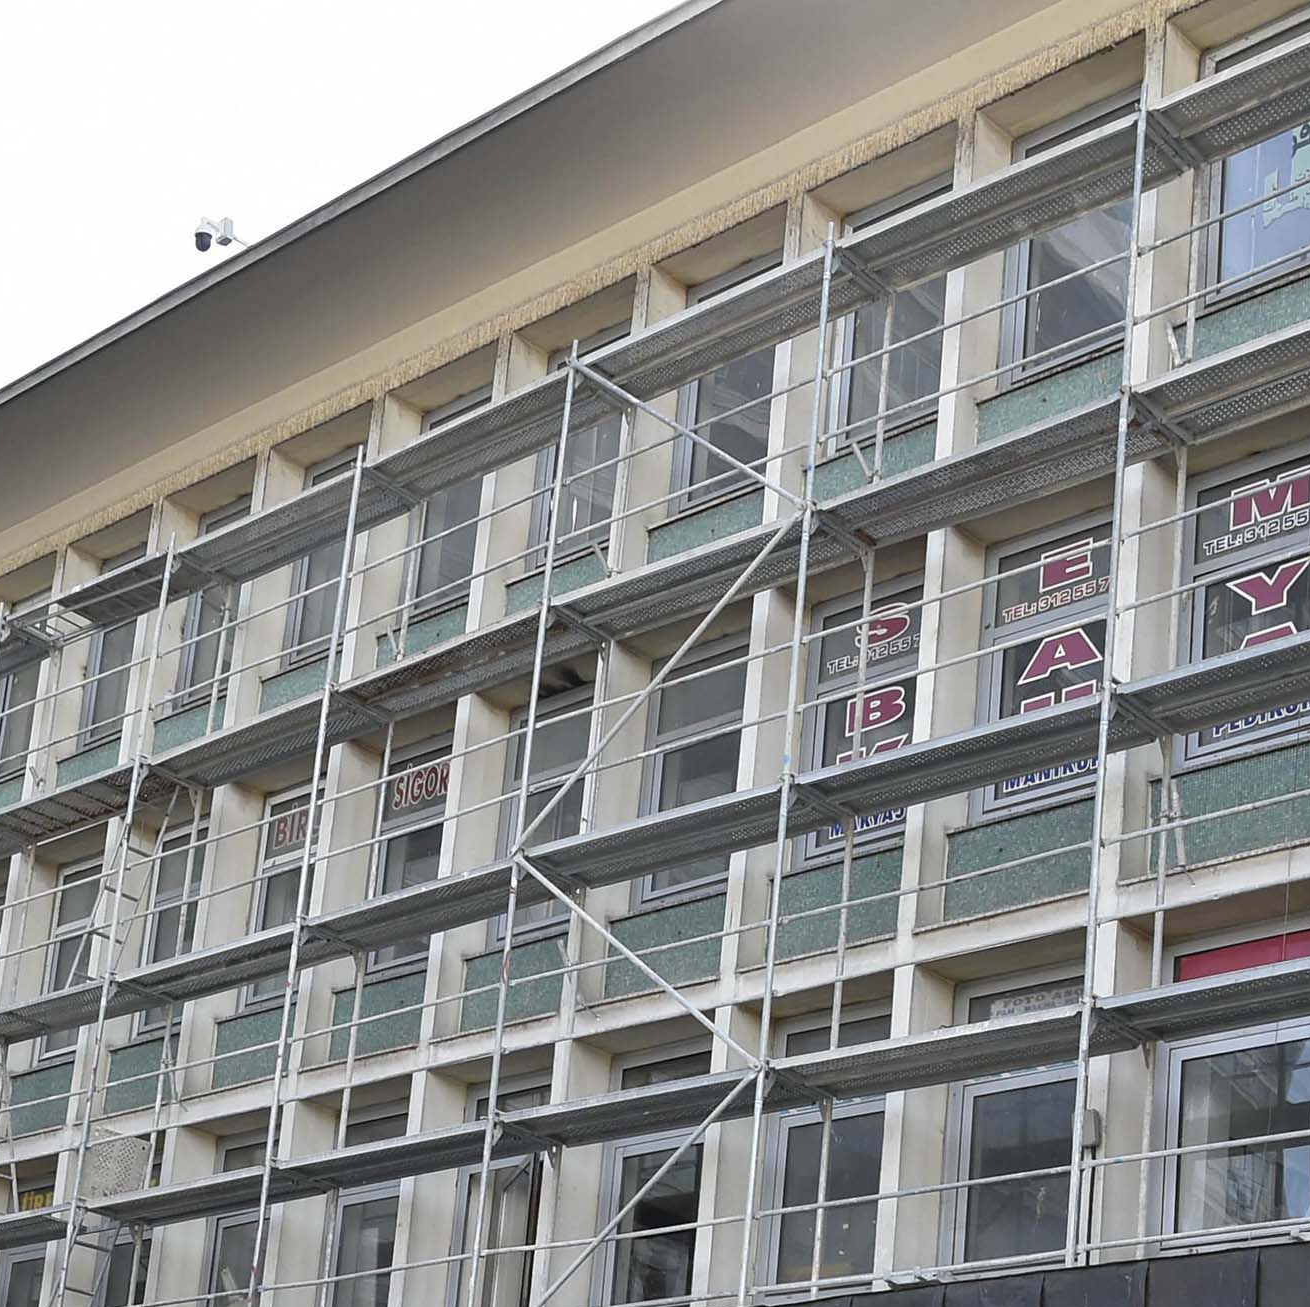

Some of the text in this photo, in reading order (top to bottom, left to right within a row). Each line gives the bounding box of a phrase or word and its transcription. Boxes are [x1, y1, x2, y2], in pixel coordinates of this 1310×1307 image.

[1203, 533, 1242, 557] TEL:
[1244, 519, 1281, 542] 312
[1282, 511, 1309, 531] 55
[1003, 602, 1037, 623] TEL:
[1038, 588, 1071, 612] 312
[1072, 579, 1096, 601] 55
[889, 636, 910, 655] 55
